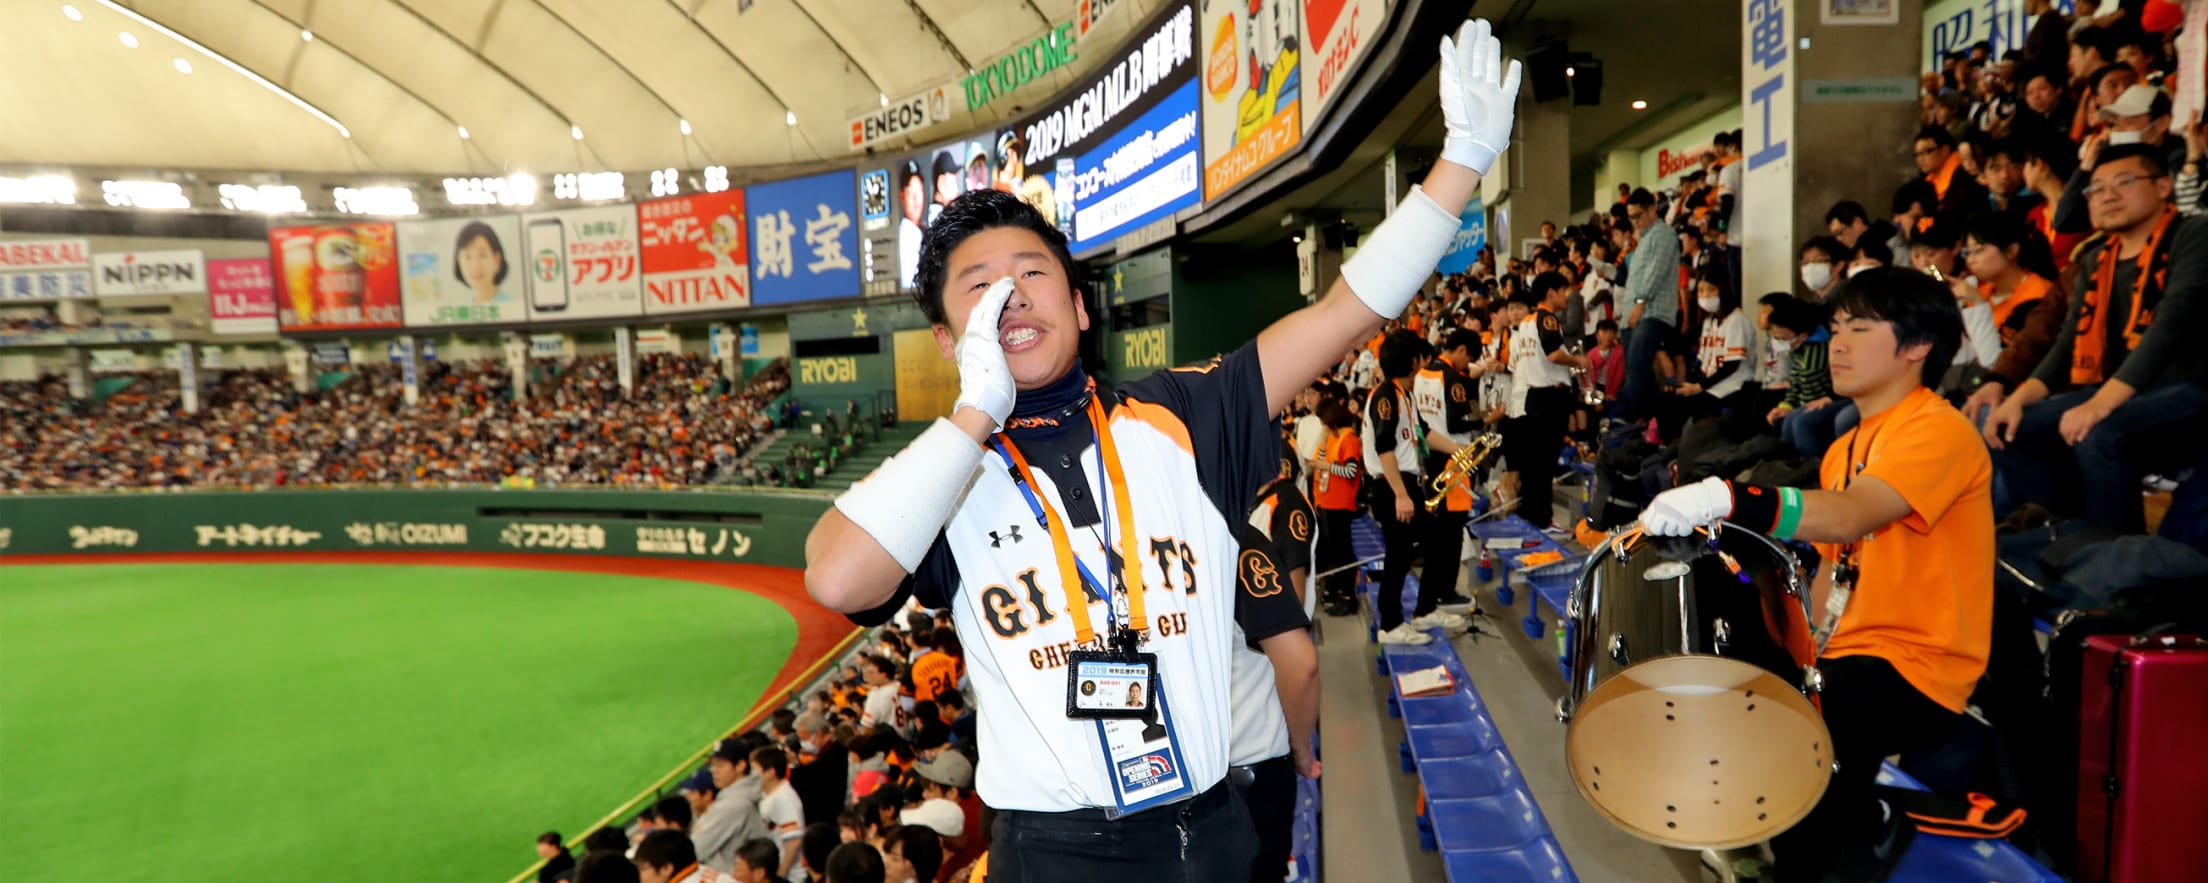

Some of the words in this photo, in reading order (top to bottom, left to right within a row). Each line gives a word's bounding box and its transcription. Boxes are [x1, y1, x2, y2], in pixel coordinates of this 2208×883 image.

[960, 54, 1018, 112] TOKYO
[1016, 21, 1078, 85] DOME
[865, 99, 923, 141] ENEOS
[1025, 110, 1064, 166] 2019
[1064, 81, 1104, 148] MGM
[642, 216, 705, 247] ニッタン
[756, 203, 852, 280] 財宝
[572, 254, 635, 285] アプリ
[647, 273, 745, 306] NITTAN
[1124, 328, 1166, 368] RYOBI
[800, 357, 857, 384] RYOBI
[401, 522, 468, 545] OIZUMI
[521, 523, 606, 549] フコク生命
[687, 526, 751, 557] セノン
[929, 671, 953, 699] 24
[1082, 666, 1108, 674] 2019
